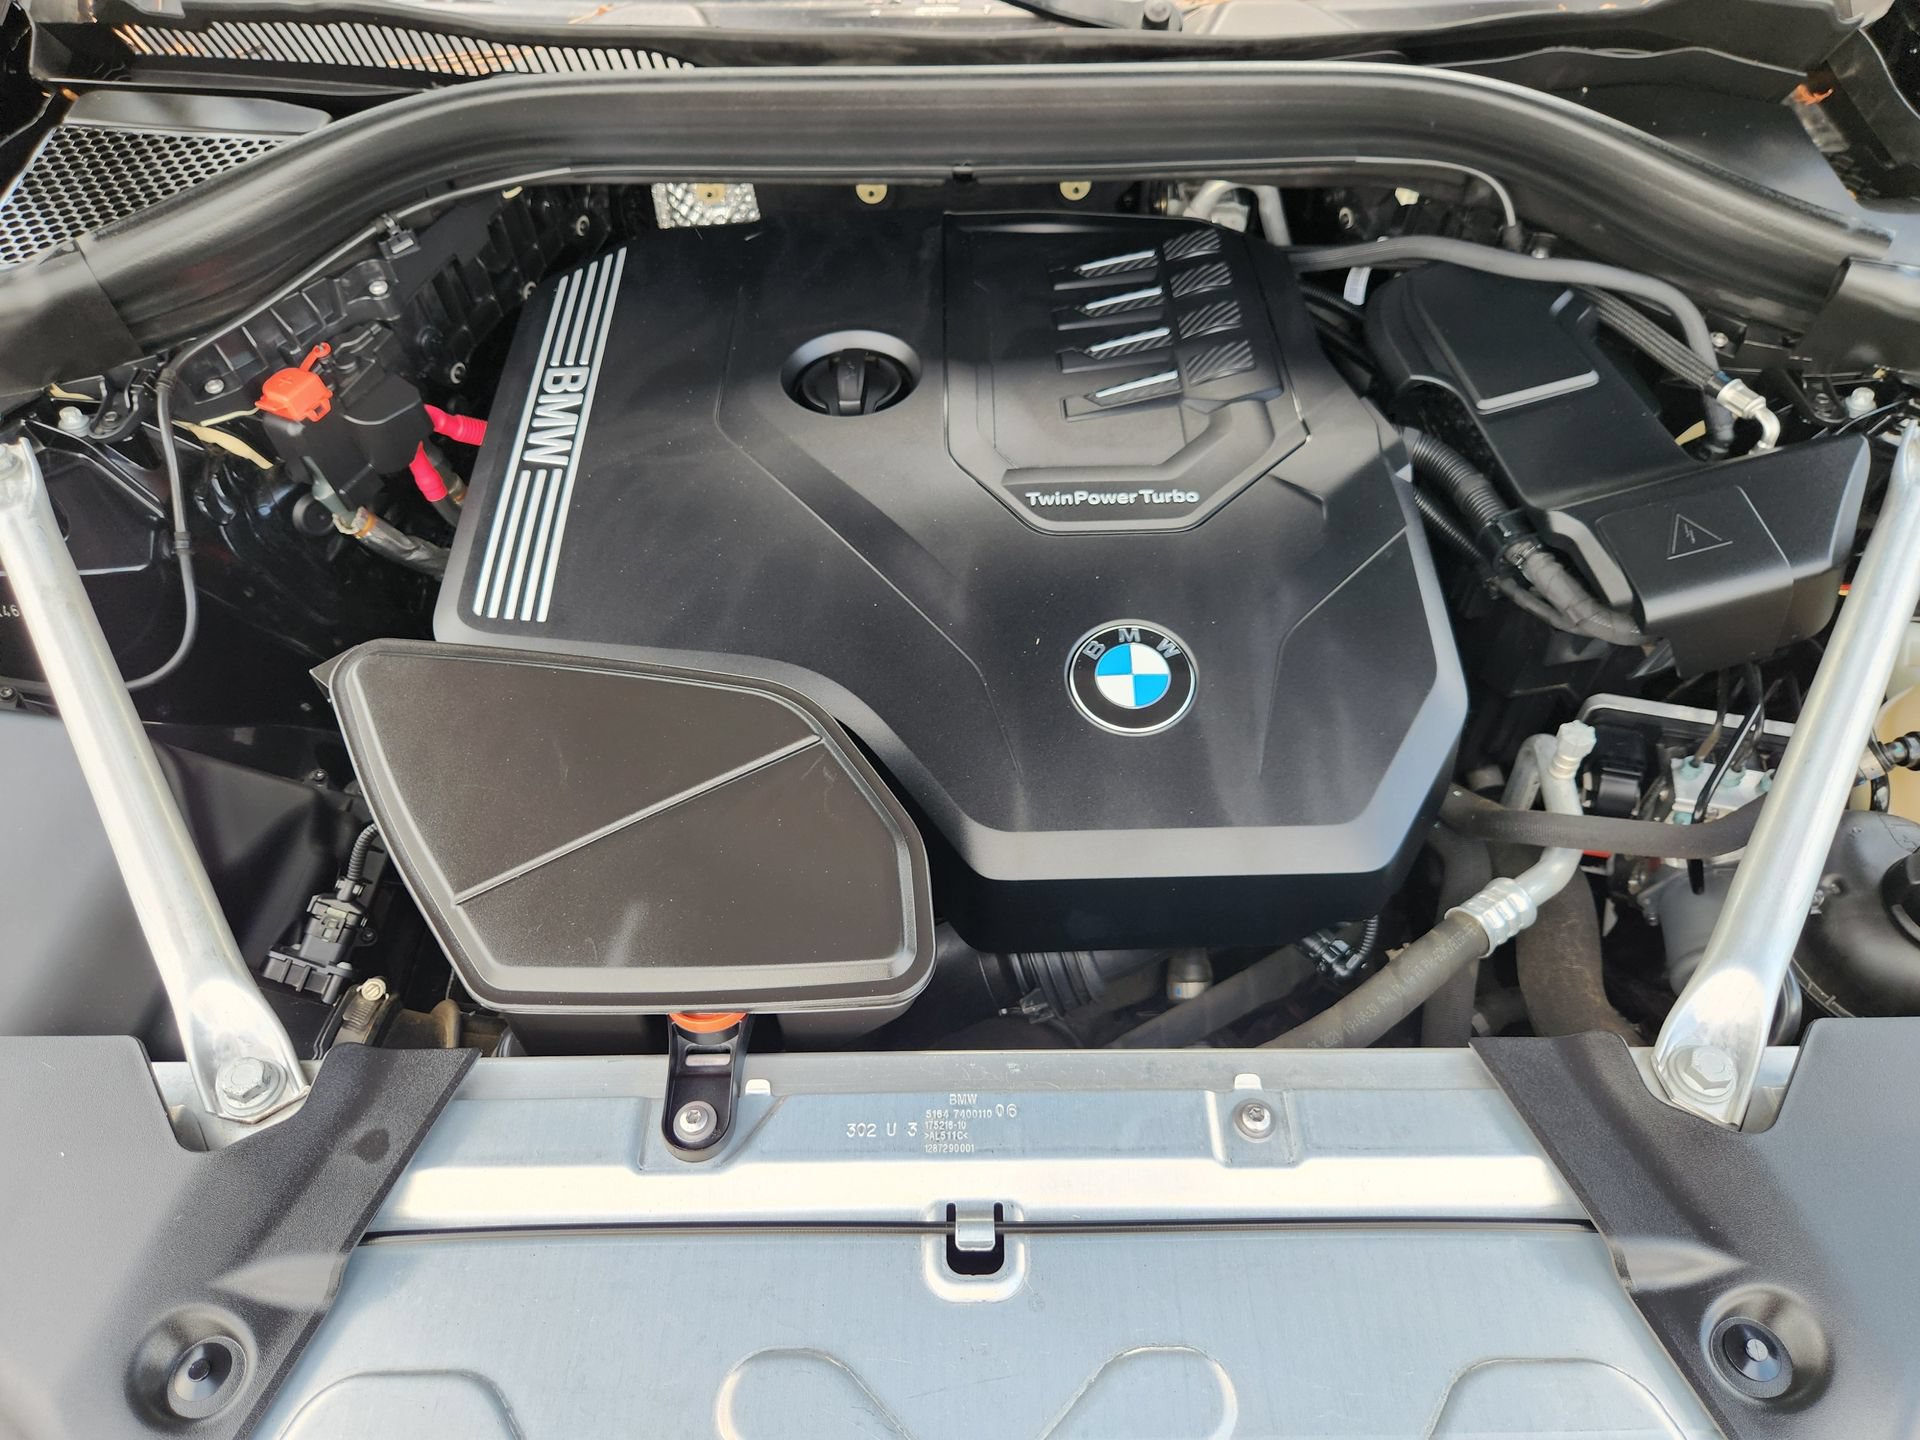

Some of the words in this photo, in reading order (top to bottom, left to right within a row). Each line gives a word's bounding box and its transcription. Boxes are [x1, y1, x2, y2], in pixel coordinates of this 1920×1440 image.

[522, 366, 590, 466] BMW
[1025, 490, 1138, 506] TwinPower
[1138, 489, 1200, 504] Turbo
[1082, 628, 1181, 660] BMW
[949, 1093, 978, 1105] BMW
[995, 1103, 1017, 1118] 06
[846, 1122, 877, 1137] 302
[886, 1122, 897, 1137] U
[907, 1122, 918, 1137] 3
[924, 1143, 975, 1153] 1287290001
